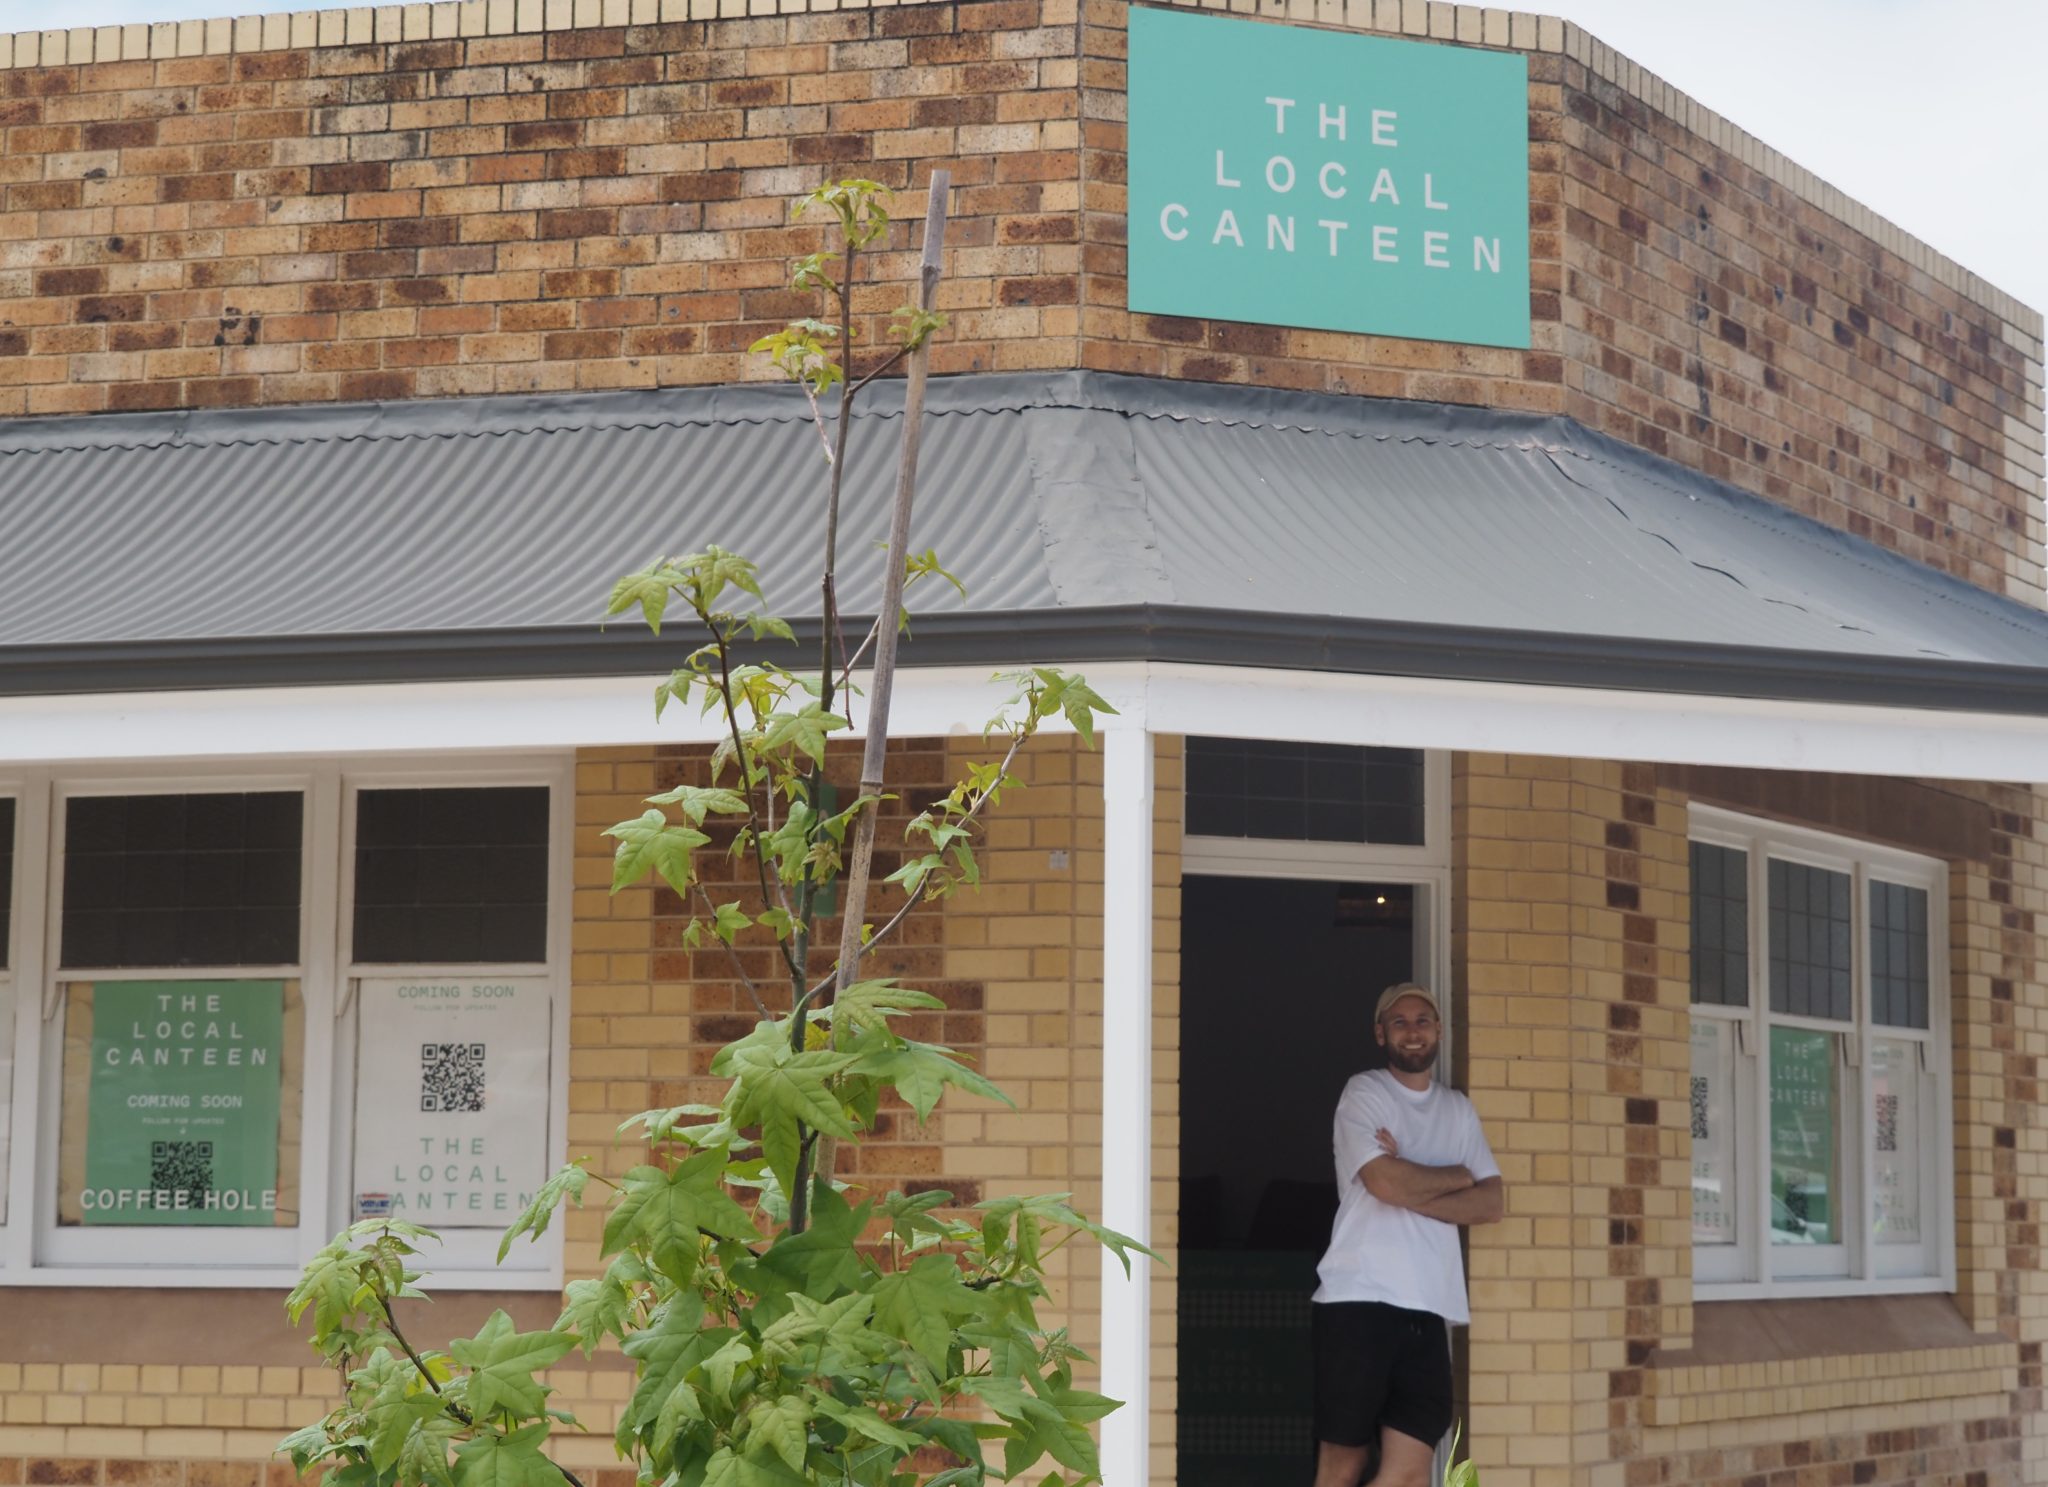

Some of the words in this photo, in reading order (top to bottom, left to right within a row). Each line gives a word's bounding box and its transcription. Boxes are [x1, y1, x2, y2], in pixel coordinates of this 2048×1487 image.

[1265, 96, 1399, 148] THE
[1215, 149, 1449, 211] LOCAL
[1159, 202, 1501, 274] CANTEEN
[397, 985, 461, 999] COMING
[472, 985, 515, 998] SOON
[157, 994, 221, 1013] THE
[132, 1021, 244, 1040] LOCAL
[105, 1047, 268, 1066] CANTEEN
[1776, 1064, 1818, 1084] LOCAL
[127, 1094, 190, 1109] COMING
[201, 1094, 243, 1108] SOON
[419, 1137, 486, 1155] THE
[394, 1164, 508, 1183] LOCAL
[79, 1188, 192, 1211] COFFEE
[205, 1188, 277, 1211] HOLE
[392, 1191, 534, 1211] ANTEEN
